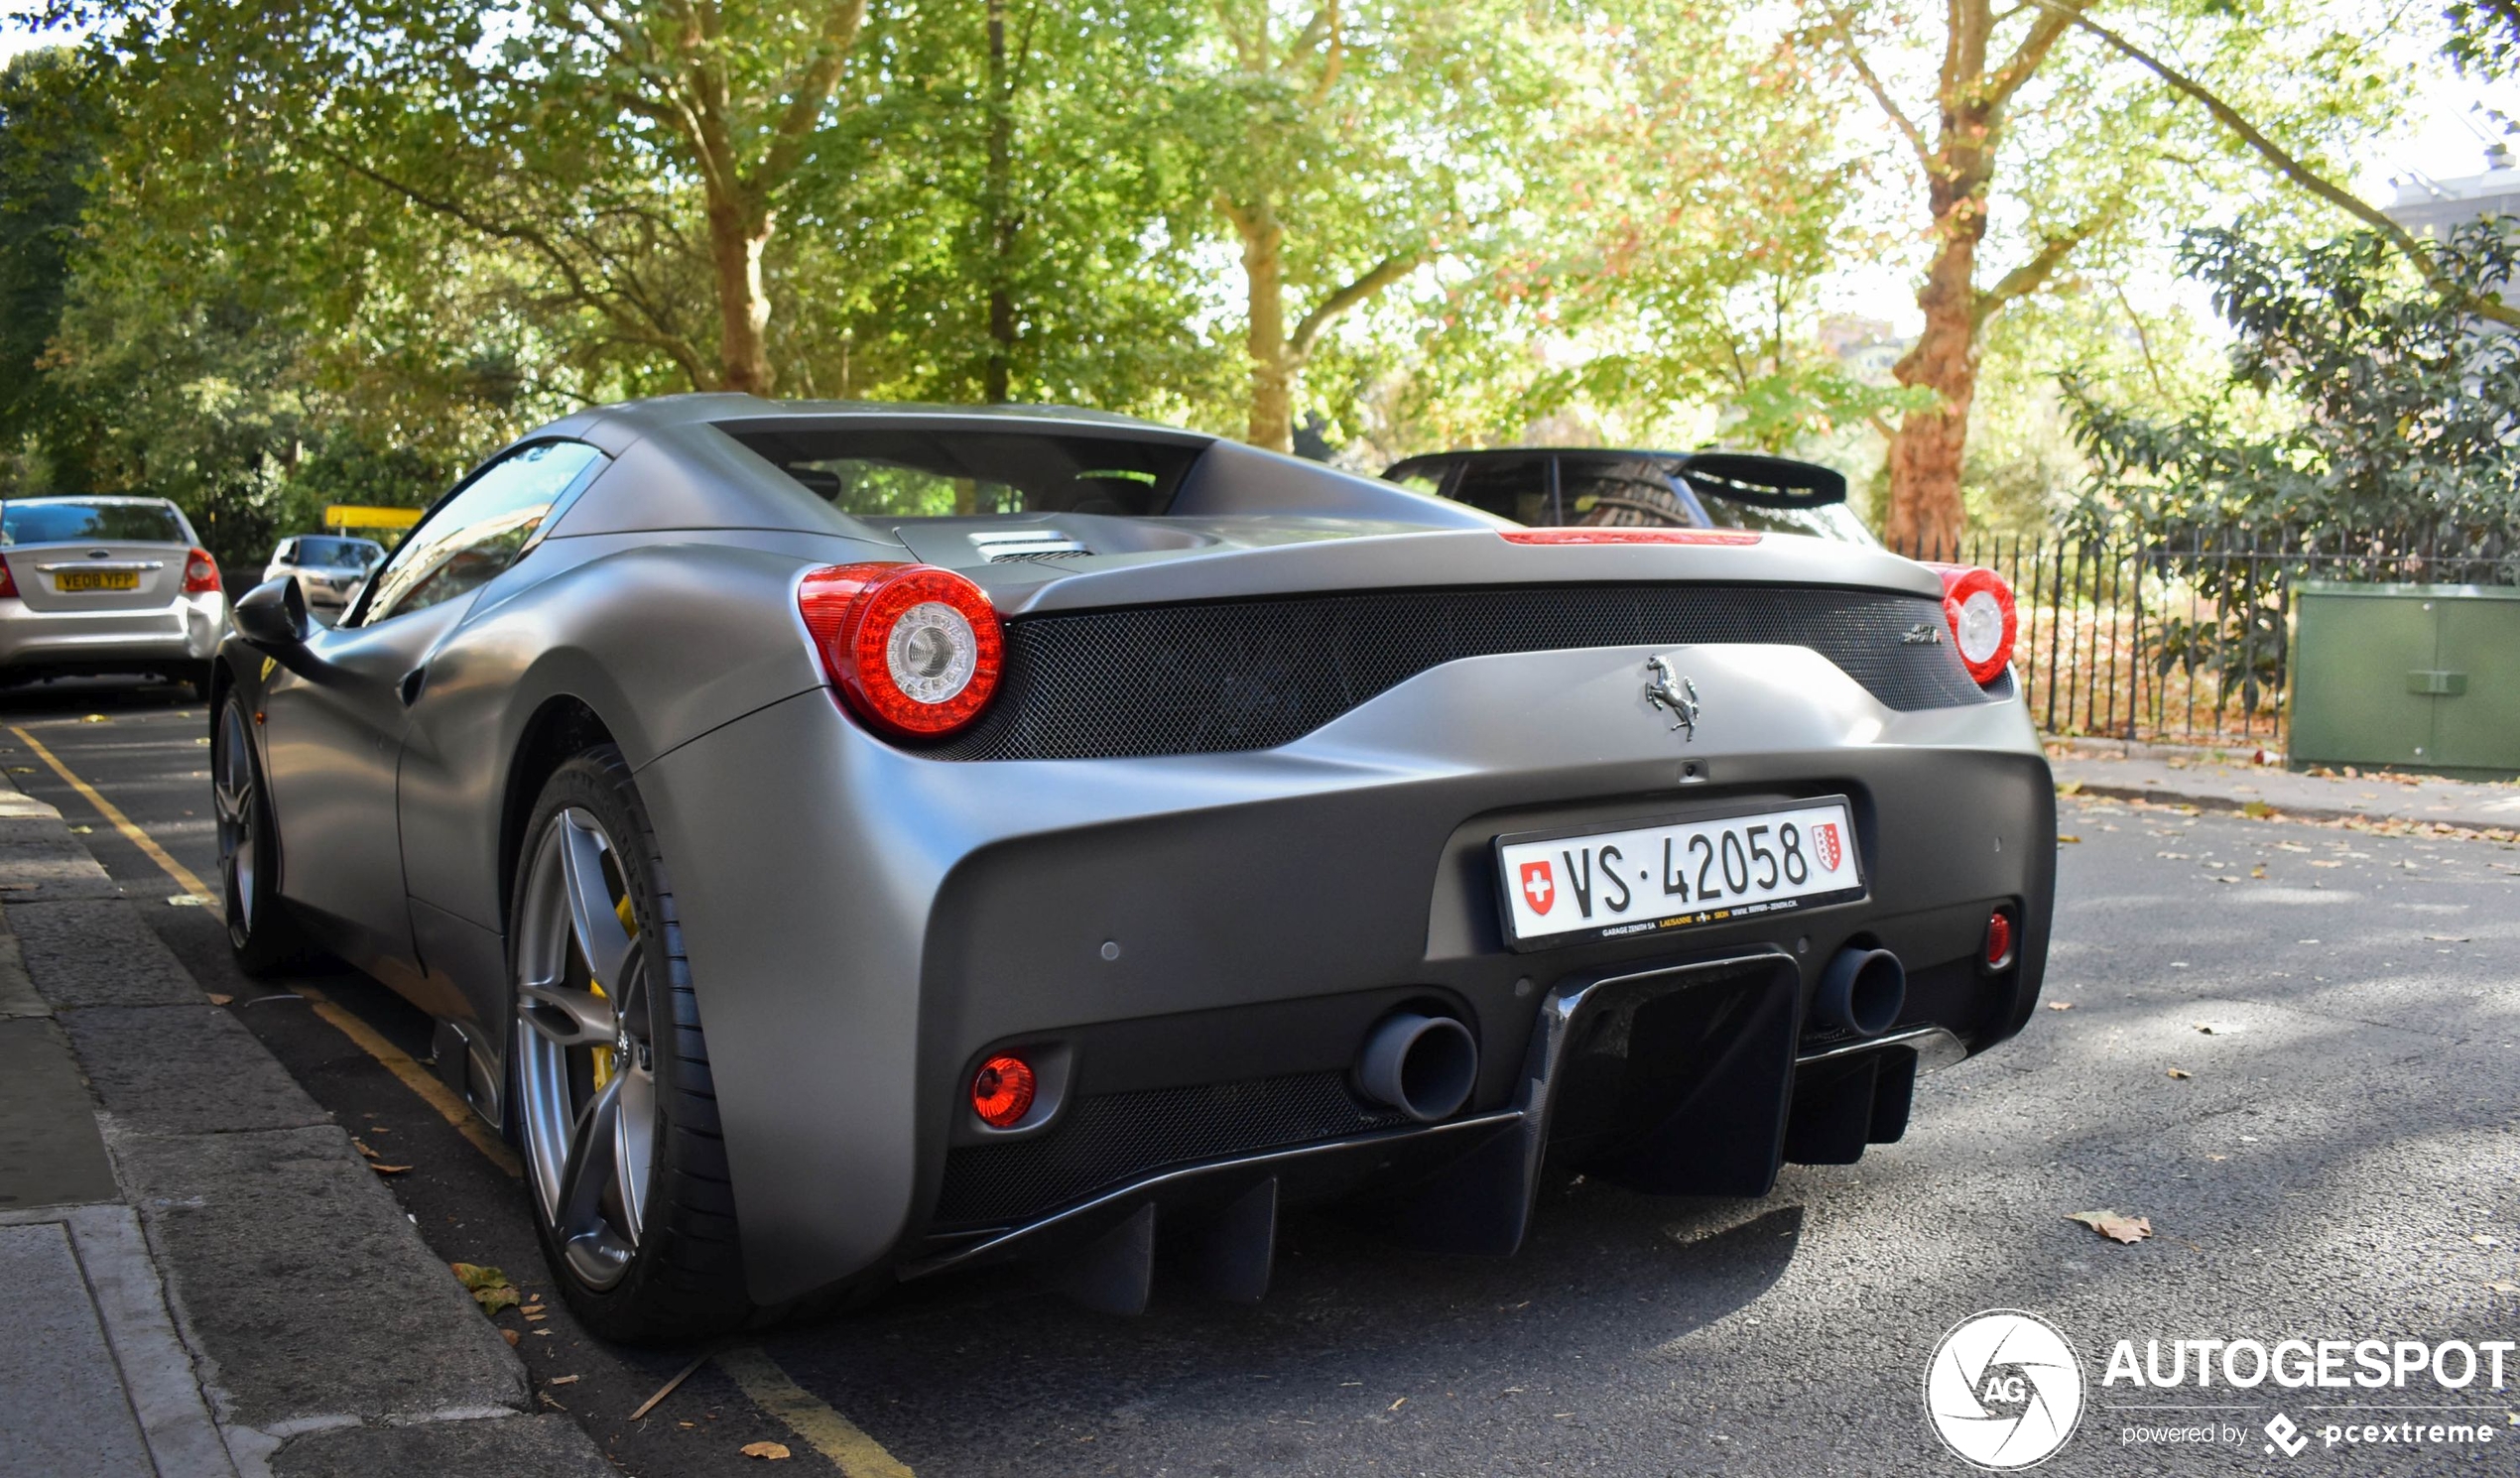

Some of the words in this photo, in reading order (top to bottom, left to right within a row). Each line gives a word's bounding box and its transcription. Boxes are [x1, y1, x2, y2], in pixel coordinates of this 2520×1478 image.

[63, 573, 99, 587] VE08
[101, 572, 133, 585] YFP
[1601, 926, 1628, 937] GARAGE
[1659, 916, 1693, 928] LAUSANNE
